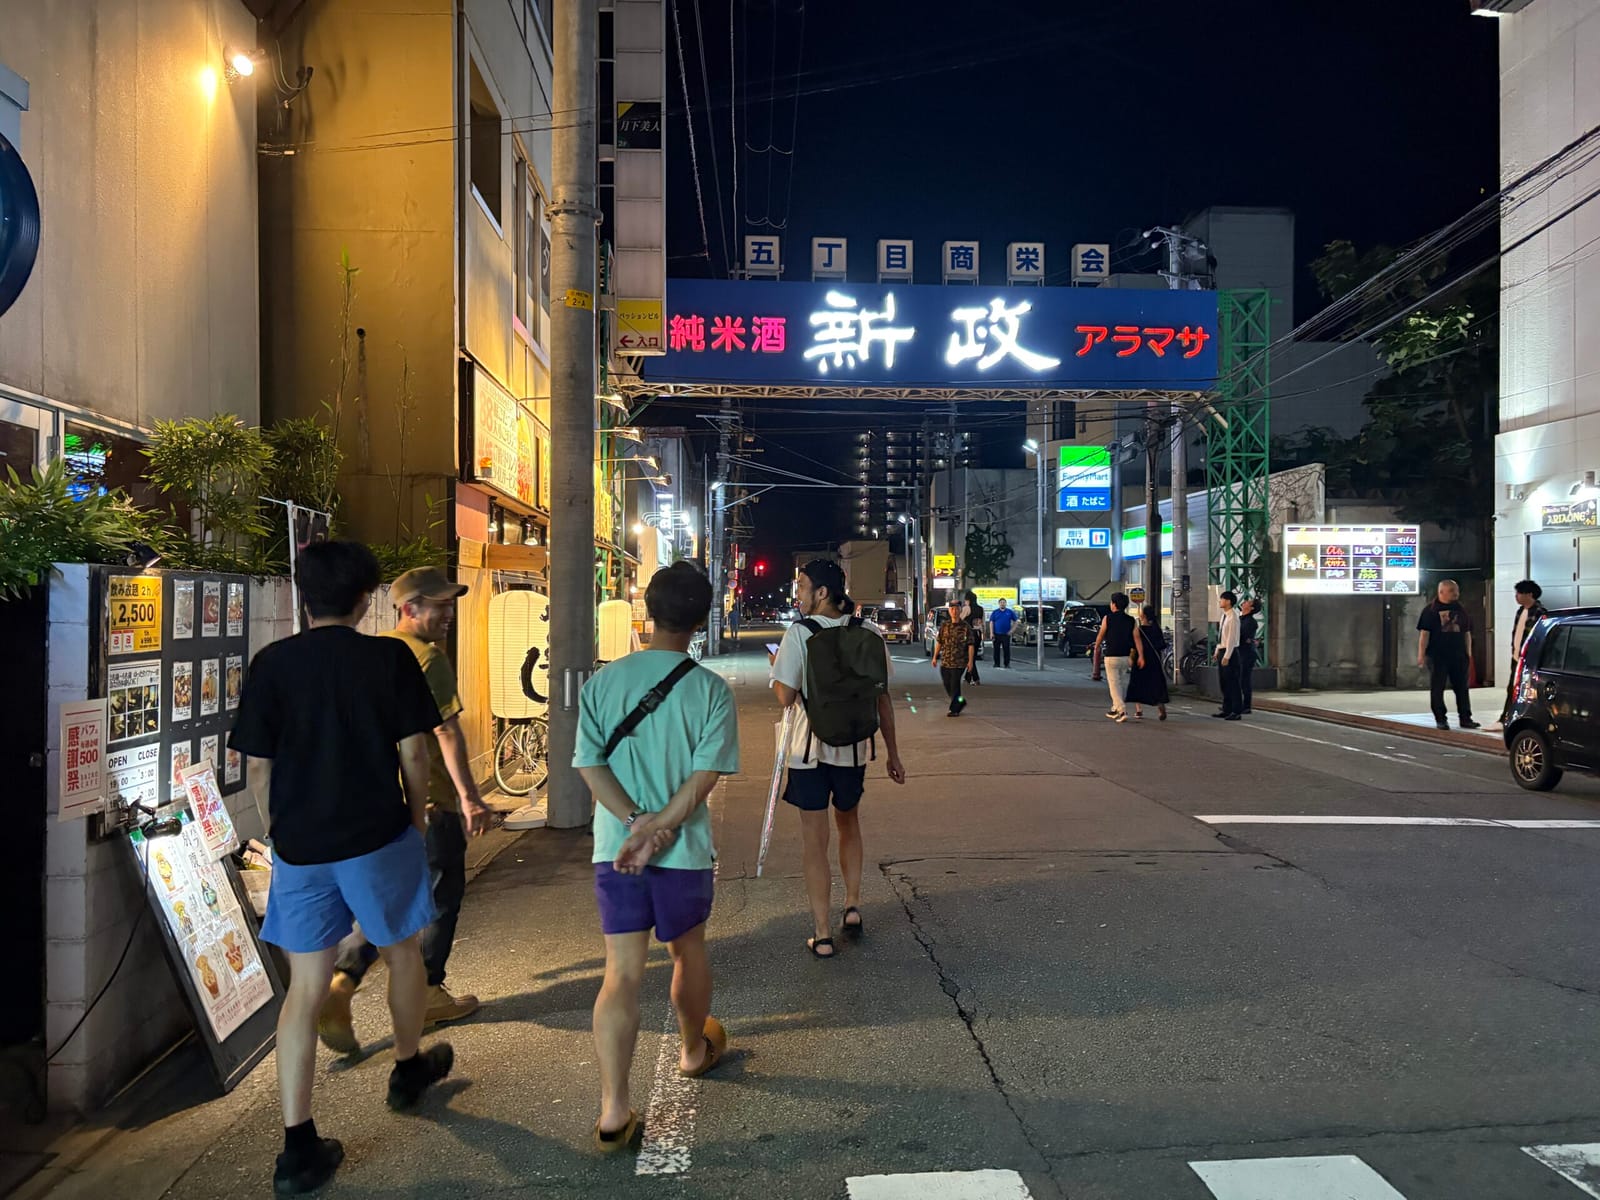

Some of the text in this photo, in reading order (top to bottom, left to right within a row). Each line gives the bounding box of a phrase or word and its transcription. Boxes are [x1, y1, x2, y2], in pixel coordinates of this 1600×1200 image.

[620, 120, 660, 132] 月下美人
[750, 241, 1105, 273] 五丁目商栄会
[669, 291, 1210, 372] 純米酒 新政 アラマサ
[636, 336, 658, 347] 入口
[1066, 495, 1105, 507] 酒 たばこ
[1065, 538, 1084, 546] ATM
[111, 583, 139, 597] 飲み放題
[67, 726, 80, 791] 感謝祭
[79, 749, 98, 766] 500
[108, 755, 128, 769] OPEN
[138, 748, 158, 761] CLOSE
